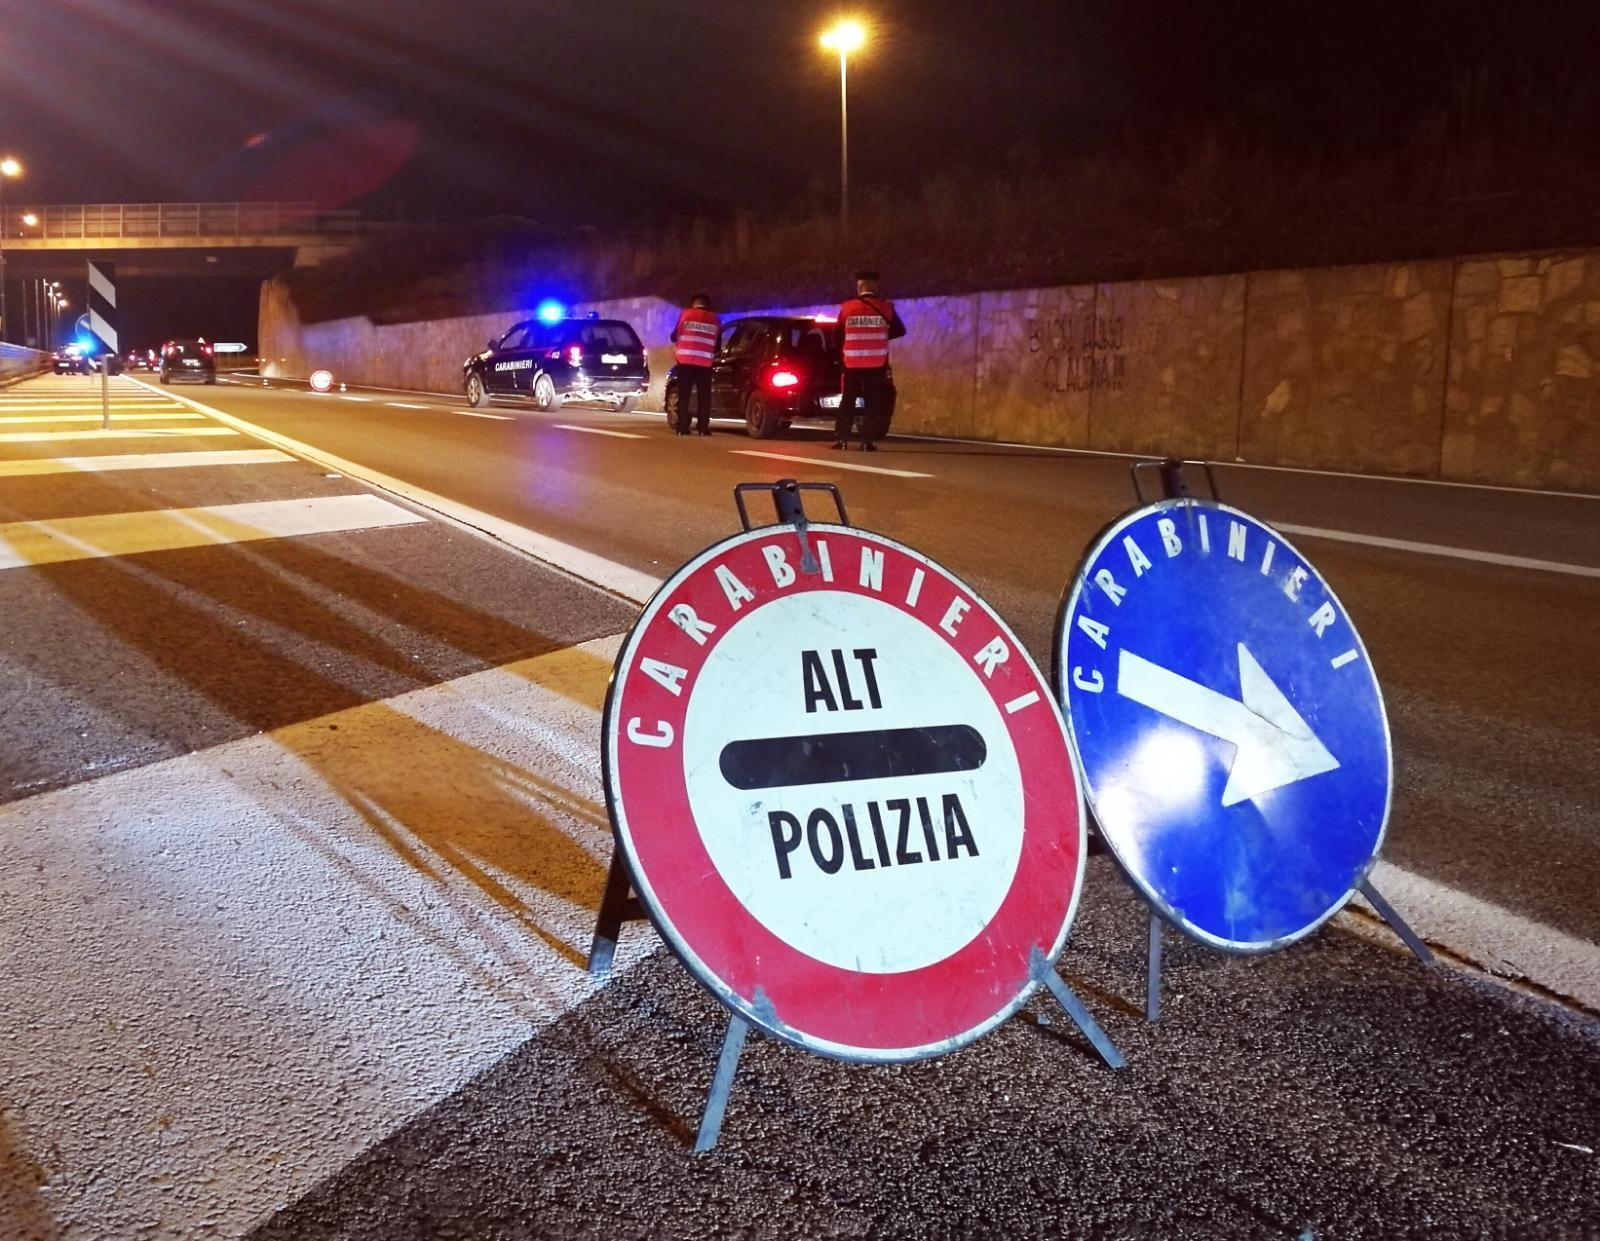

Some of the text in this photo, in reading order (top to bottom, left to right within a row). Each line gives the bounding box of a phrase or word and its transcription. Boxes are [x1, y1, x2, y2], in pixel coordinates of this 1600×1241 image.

[495, 359, 533, 372] CARABINIERI
[626, 539, 1041, 749] CARABINIERI
[1072, 514, 1359, 694] CARABINIERI
[801, 648, 883, 713] ALT
[767, 793, 980, 880] POLIZIA
